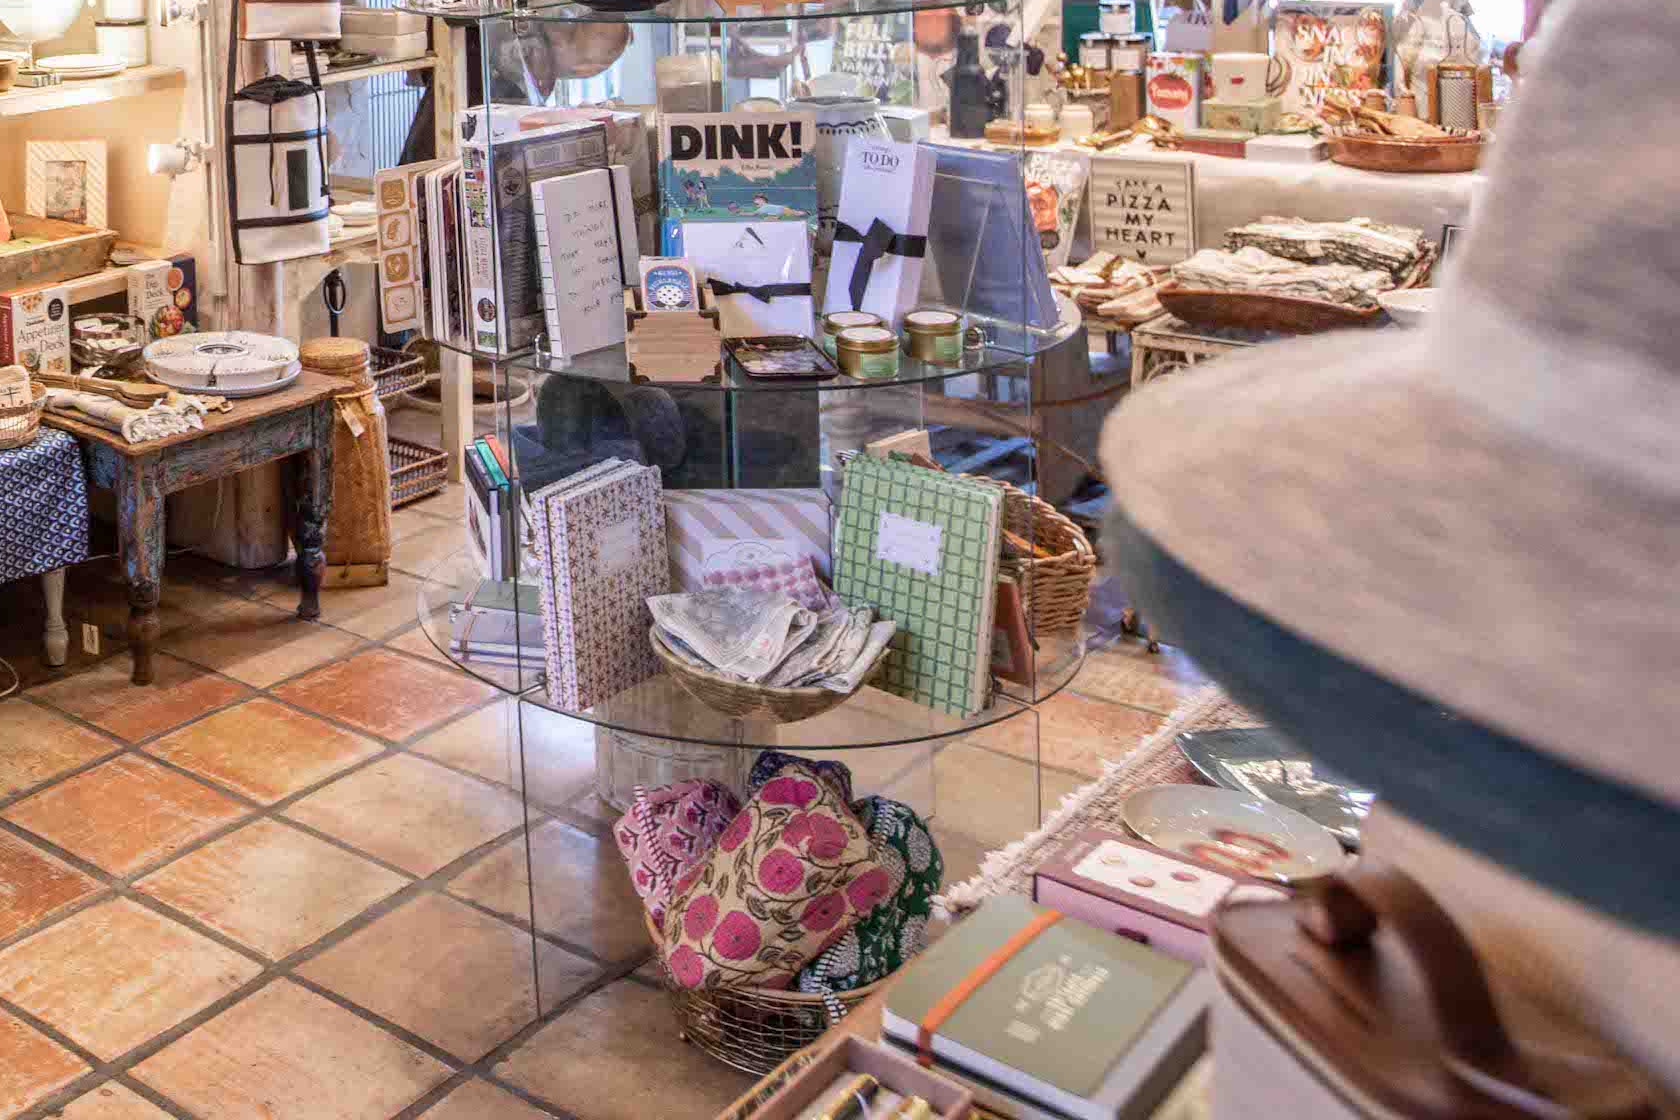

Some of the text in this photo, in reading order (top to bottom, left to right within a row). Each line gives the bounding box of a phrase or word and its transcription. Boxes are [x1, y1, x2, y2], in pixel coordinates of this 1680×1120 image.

[671, 121, 802, 160] DINK!
[863, 151, 900, 167] TO DO
[1156, 184, 1164, 193] A
[1106, 193, 1172, 211] PIZZA
[1125, 214, 1154, 227] MY
[1105, 227, 1175, 245] HEART
[146, 288, 165, 299] Deck
[17, 322, 66, 344] Appetizer
[40, 335, 66, 354] Deck
